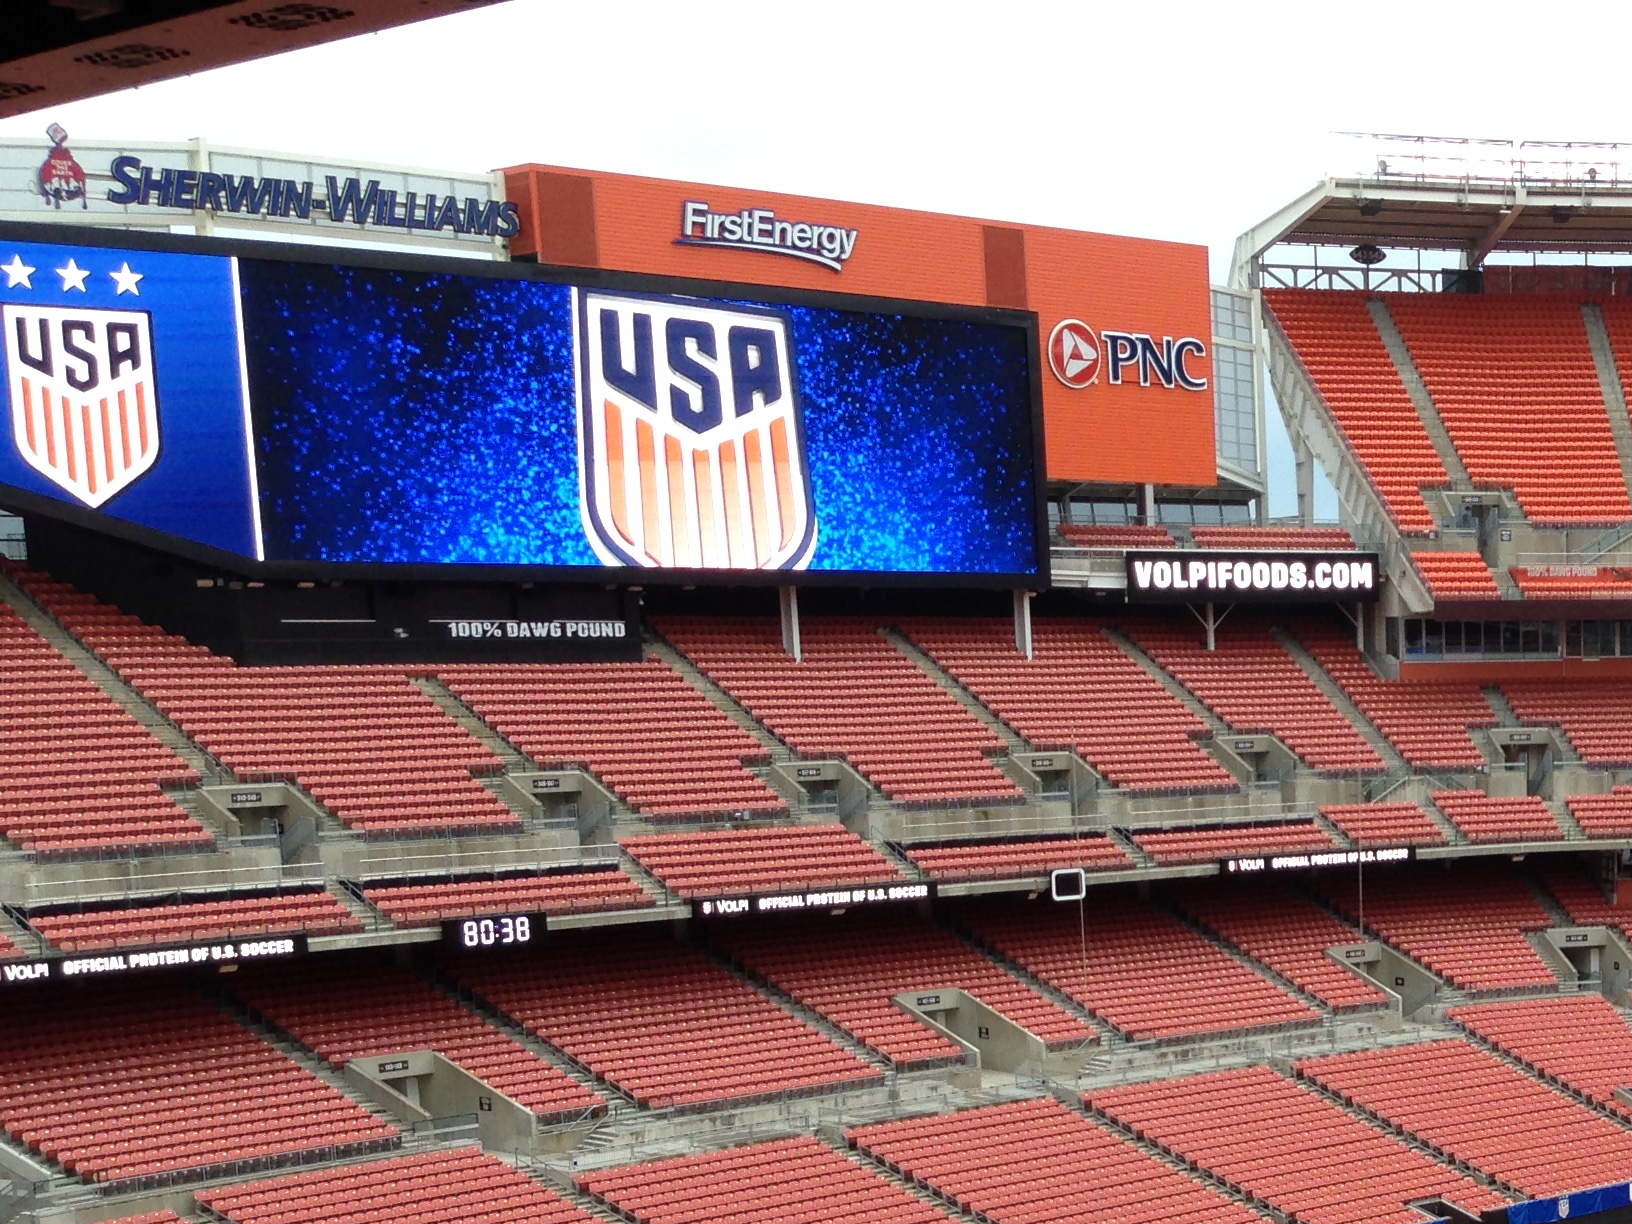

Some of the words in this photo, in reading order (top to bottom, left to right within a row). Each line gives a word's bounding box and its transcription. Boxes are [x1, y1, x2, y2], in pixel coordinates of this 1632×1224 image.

[108, 155, 520, 238] SHERWIN-WILLIAMS
[683, 201, 857, 258] FirstEnergy
[16, 316, 142, 393] USA
[600, 309, 782, 433] USA
[1102, 330, 1208, 390] PNC
[1134, 561, 1373, 589] VOLPIFOODS.COM
[448, 623, 502, 638] 100%
[507, 622, 561, 638] DAWG
[566, 622, 626, 638] POUND
[5, 964, 48, 980] VOLPI
[63, 955, 127, 974] OFFICIAL
[130, 949, 188, 968] PROTEIN
[192, 947, 208, 962] OF
[212, 944, 238, 960] U.S.
[240, 939, 294, 958] SOCCER
[463, 916, 531, 946] 80:38
